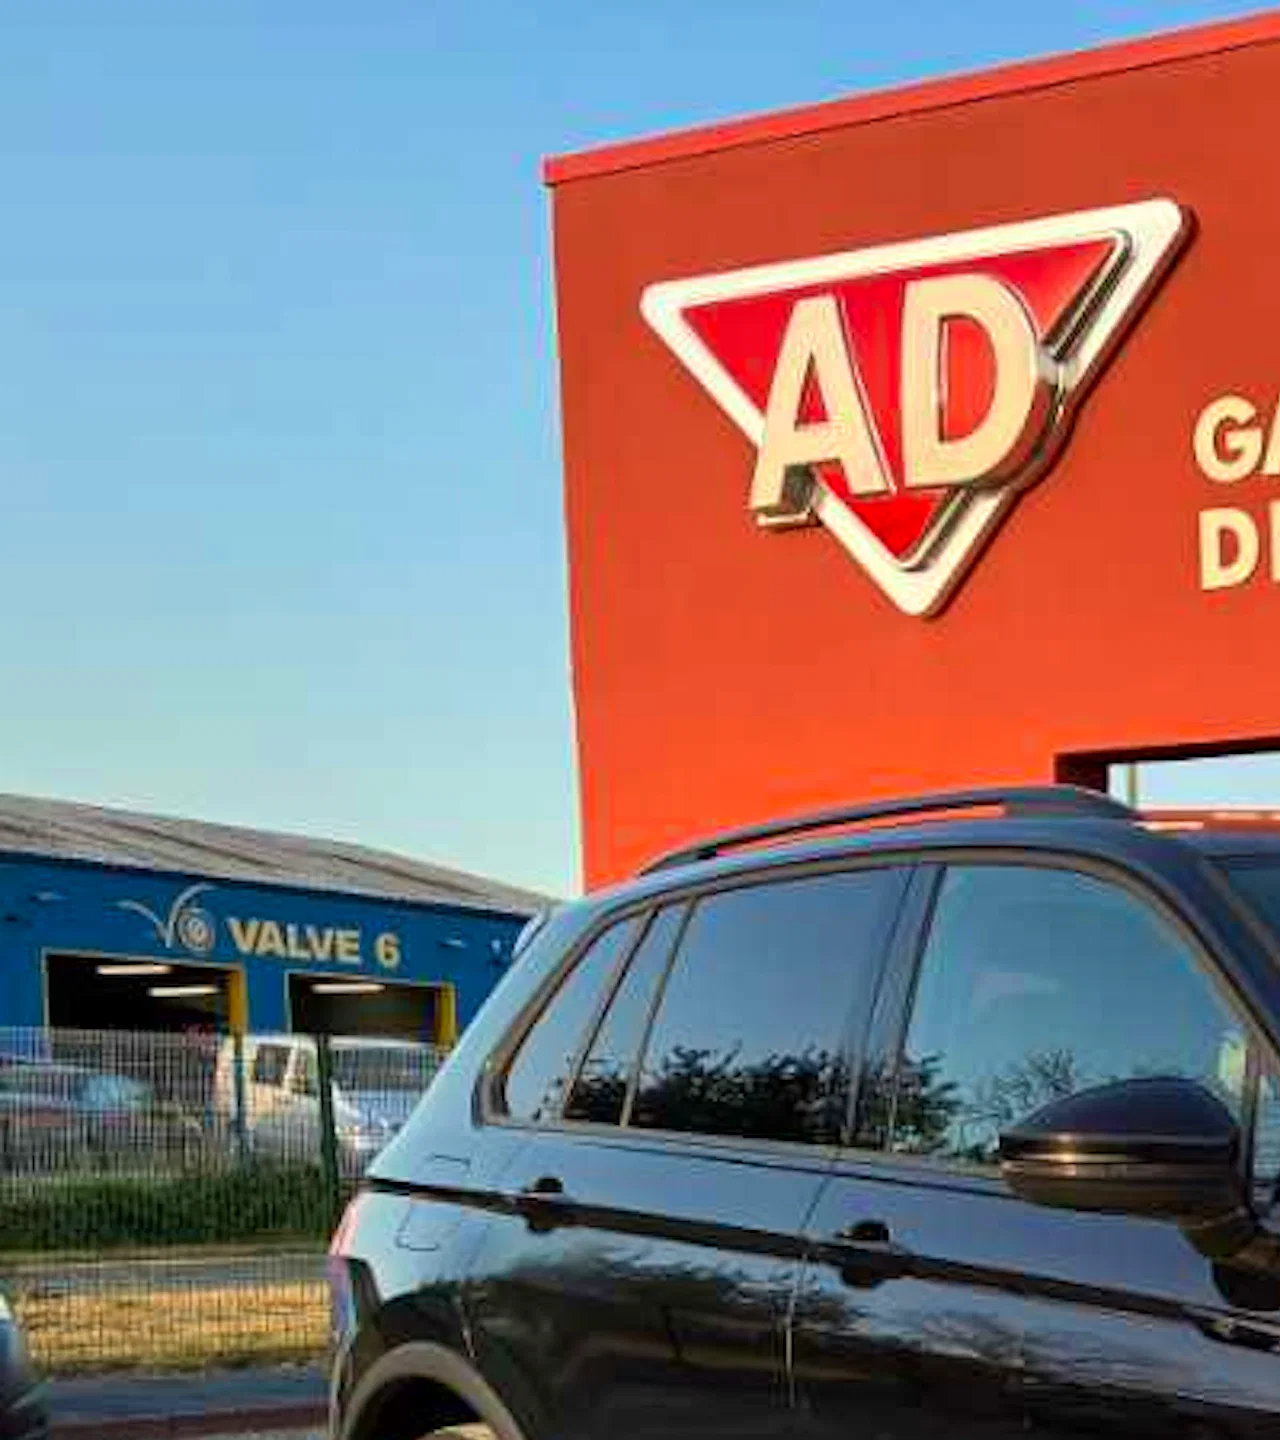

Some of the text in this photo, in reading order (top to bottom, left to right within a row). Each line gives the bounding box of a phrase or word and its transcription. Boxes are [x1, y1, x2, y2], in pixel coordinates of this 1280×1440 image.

[749, 272, 1040, 516] AD
[226, 916, 402, 970] VALVE 6
